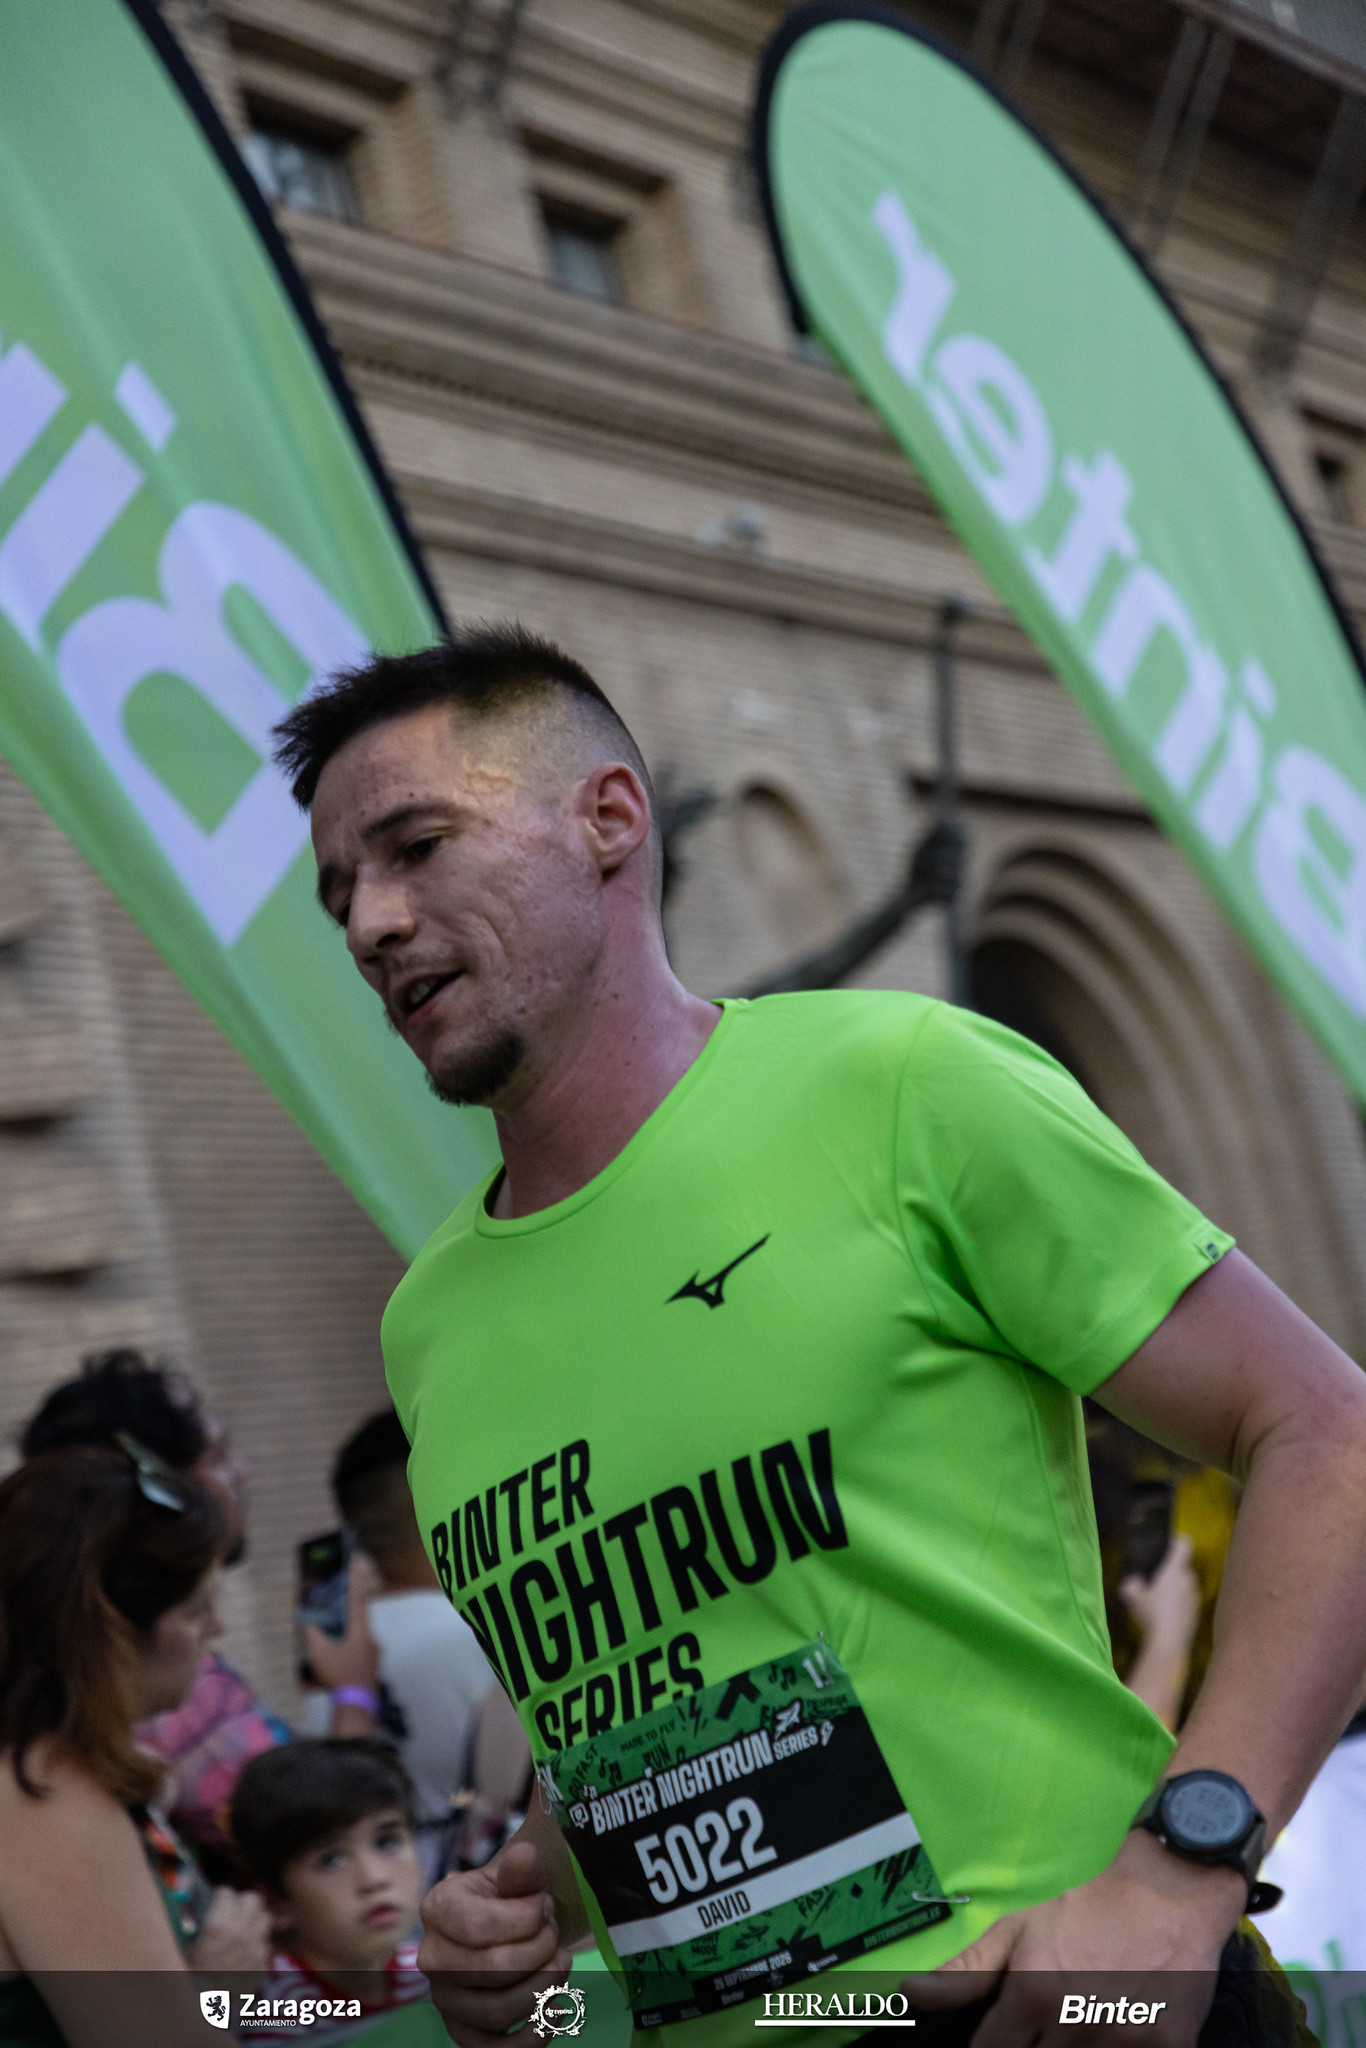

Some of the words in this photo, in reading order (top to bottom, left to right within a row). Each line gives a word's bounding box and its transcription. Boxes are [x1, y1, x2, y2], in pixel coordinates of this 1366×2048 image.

[431, 1438, 595, 1604] BINTER
[534, 1632, 704, 1752] SERIES
[589, 1779, 659, 1836] BINTER
[655, 1729, 774, 1809] NIGHTRUN
[773, 1725, 819, 1761] SERIES
[634, 1796, 777, 1904] 5022
[697, 1890, 751, 1929] DAVID
